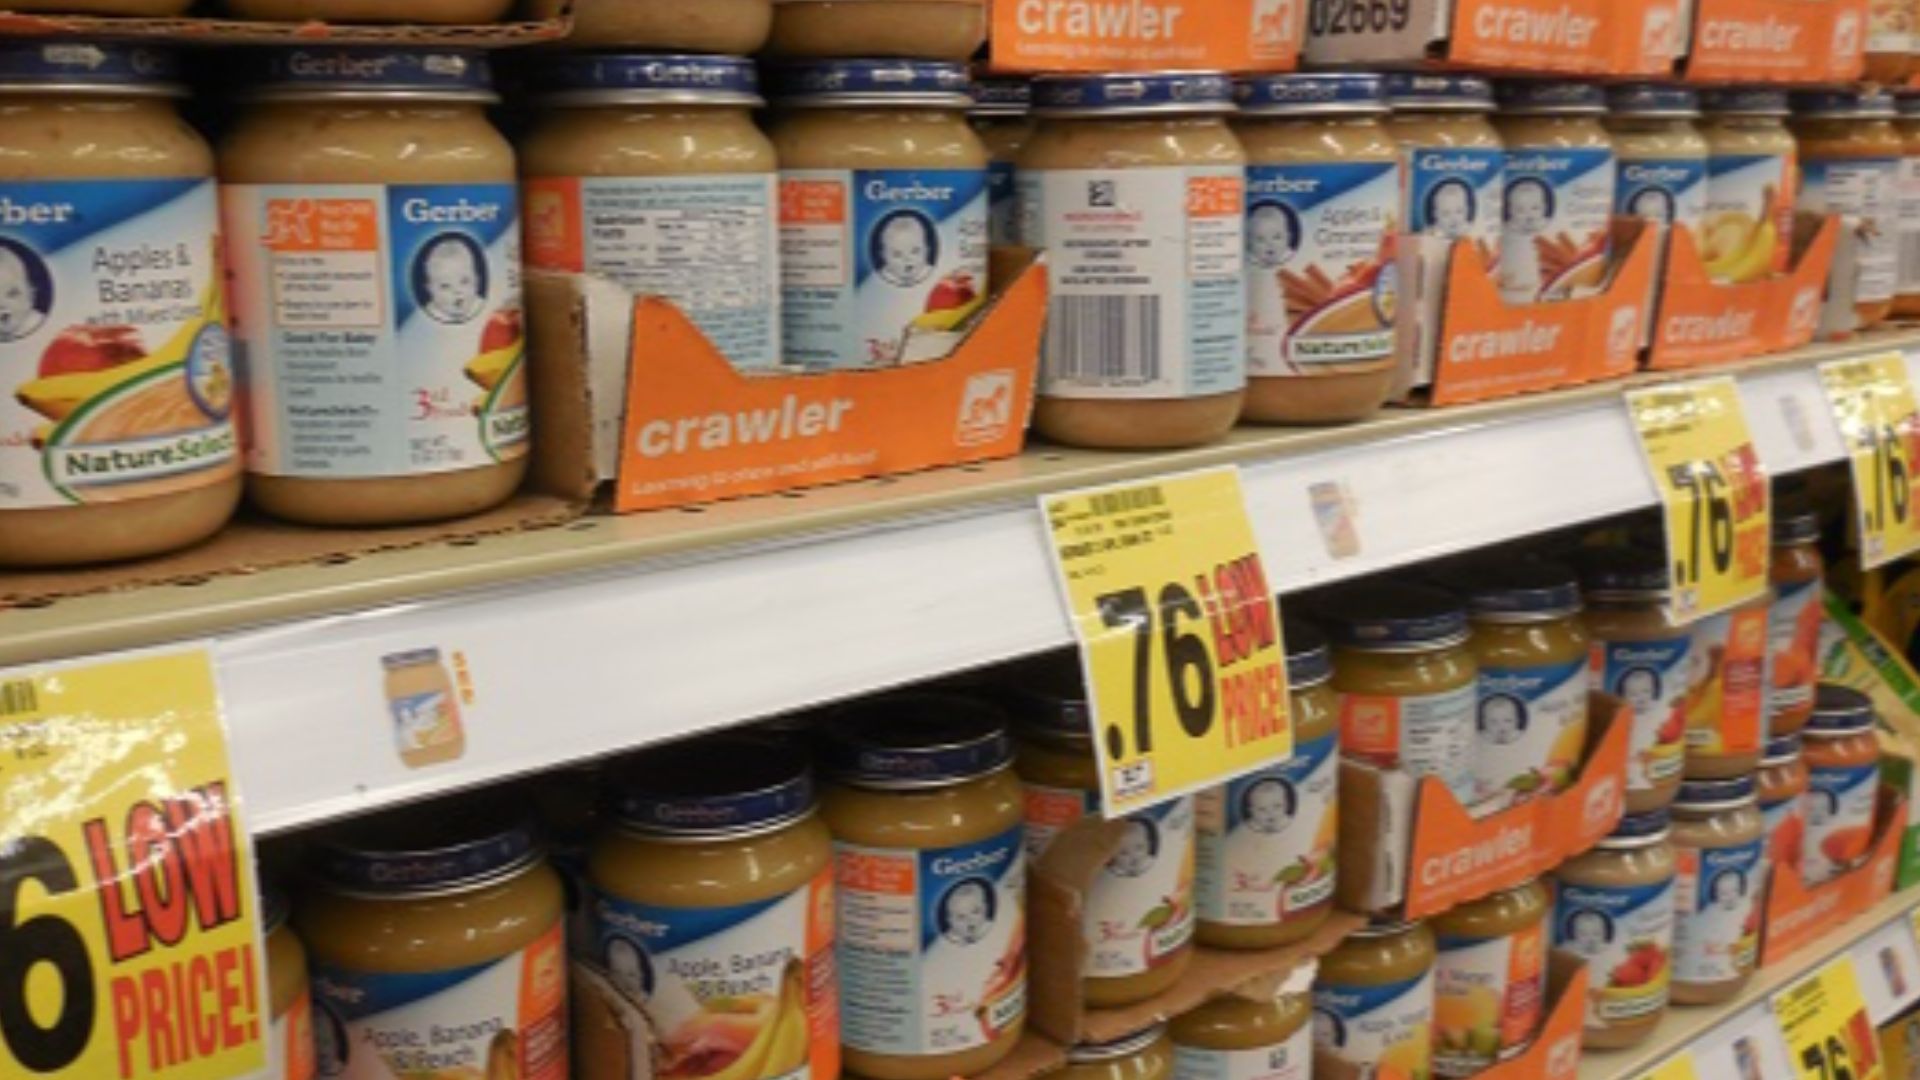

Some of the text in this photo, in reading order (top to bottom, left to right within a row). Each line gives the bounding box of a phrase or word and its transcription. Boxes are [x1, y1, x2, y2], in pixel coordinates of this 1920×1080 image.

[1016, 0, 1184, 41] crawler
[1473, 3, 1597, 48] crawler
[1701, 15, 1801, 52] crawler
[289, 51, 387, 77] Gerber
[646, 61, 724, 86] Gerber
[1421, 154, 1489, 171] Gerber
[864, 178, 953, 201] Gerber
[402, 198, 501, 224] Gerber
[93, 243, 191, 277] Apples &
[99, 278, 193, 302] Bananas
[1451, 319, 1563, 363] crawler
[1665, 309, 1757, 343] crawler
[637, 394, 854, 457] crawler
[1195, 552, 1277, 668] LOW
[1096, 582, 1216, 762] .76
[931, 846, 1010, 876] Gerber
[1422, 822, 1533, 886] crawler
[82, 780, 242, 965] LOW
[667, 957, 722, 979] Apple,
[110, 943, 261, 1080] PRICE!
[363, 1013, 504, 1049] Apple, Banana
[413, 1042, 476, 1070] Peach
